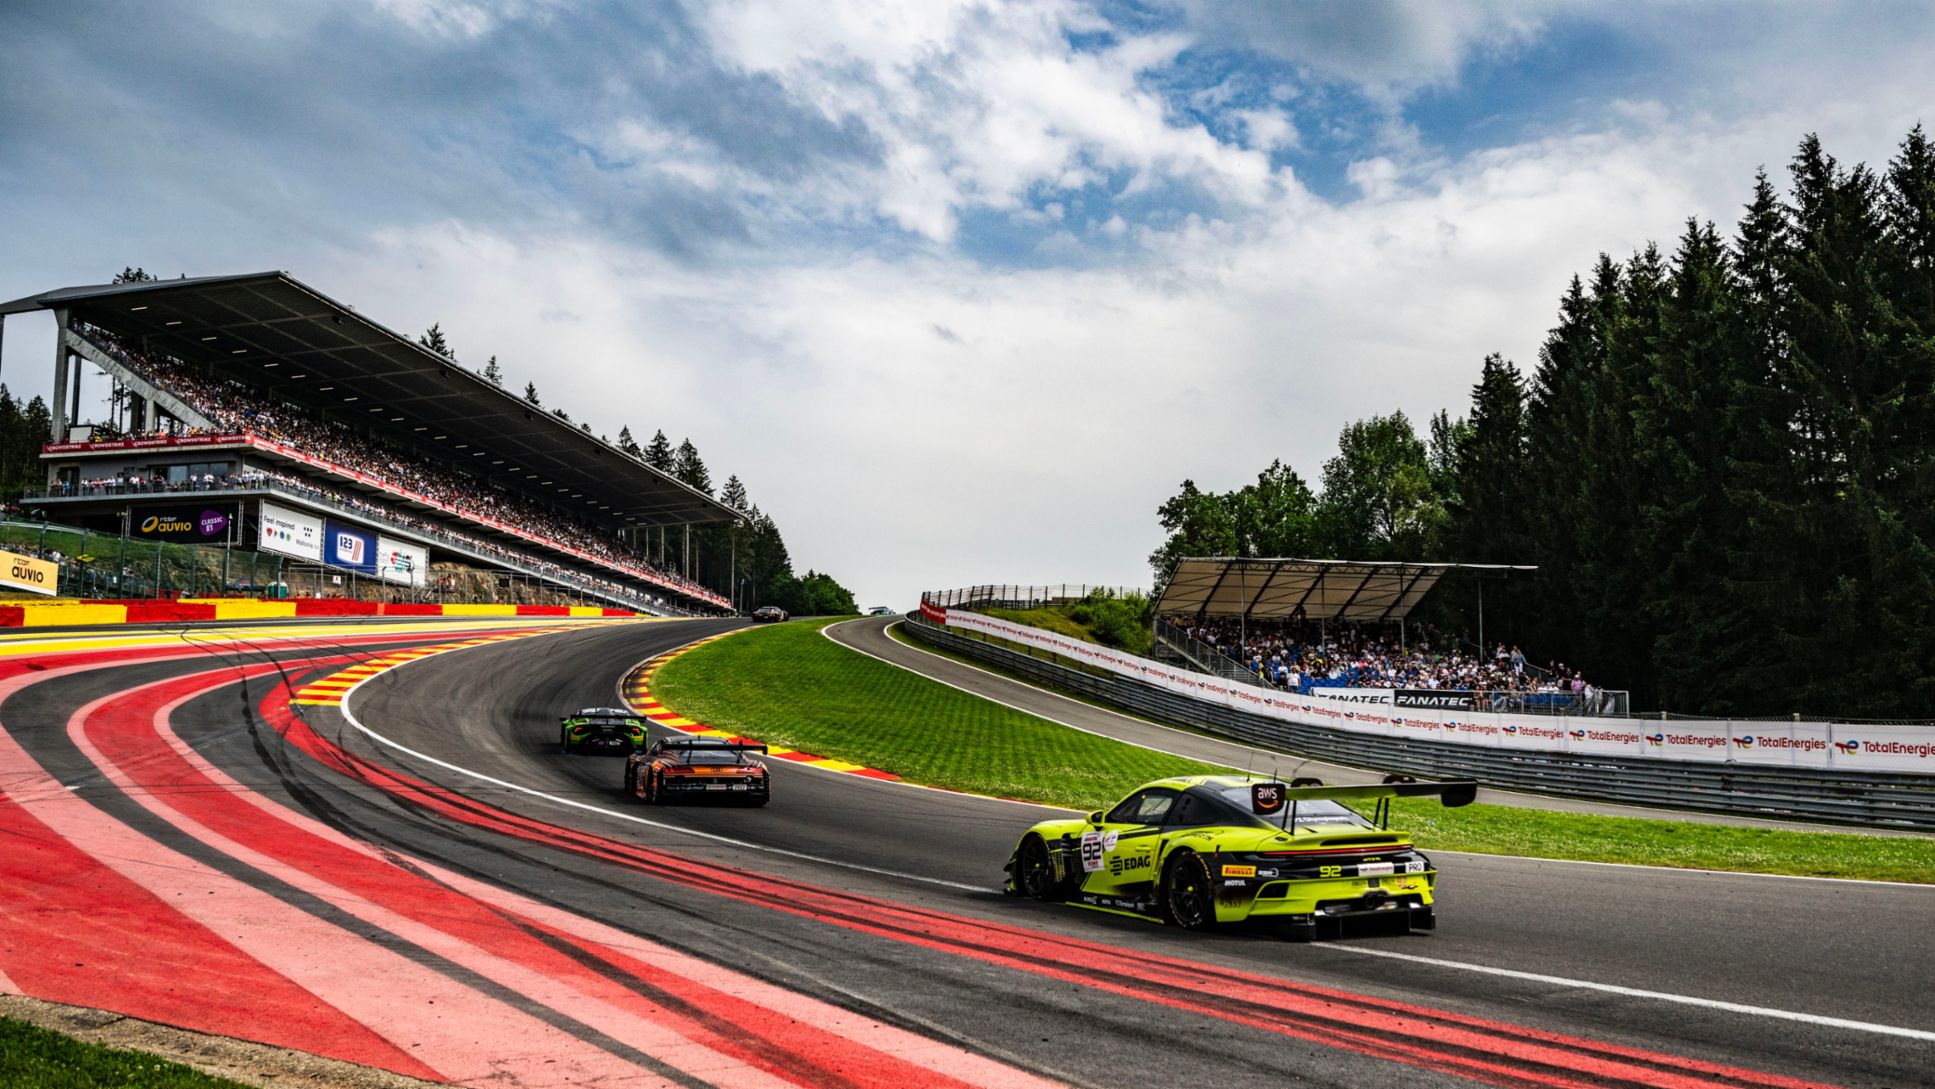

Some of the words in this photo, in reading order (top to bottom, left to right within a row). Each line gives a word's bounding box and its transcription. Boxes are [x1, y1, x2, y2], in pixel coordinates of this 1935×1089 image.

[158, 521, 192, 532] auvio
[201, 516, 223, 526] CLASSIC
[263, 515, 274, 524] Feel
[276, 519, 296, 530] inspired
[205, 524, 214, 532] 21
[339, 536, 353, 549] 123
[12, 565, 44, 583] auvio
[1397, 695, 1469, 706] FANATEC
[1312, 706, 1342, 719] TotalEnergies
[1356, 712, 1388, 724] TotalEnergies
[1404, 718, 1440, 731] TotalEnergies
[1458, 722, 1498, 735] TotalEnergies
[1518, 726, 1564, 740] TotalEnergies
[1587, 730, 1640, 743] TotalEnergies
[1666, 734, 1727, 748] TotalEnergies
[1757, 736, 1826, 752] TotalEnergies
[1257, 787, 1278, 799] aws
[1083, 841, 1101, 861] 92
[1124, 855, 1151, 870] EDAG
[1408, 862, 1422, 872] PRO
[1225, 866, 1253, 875] PIRELLI
[1319, 865, 1342, 877] 92
